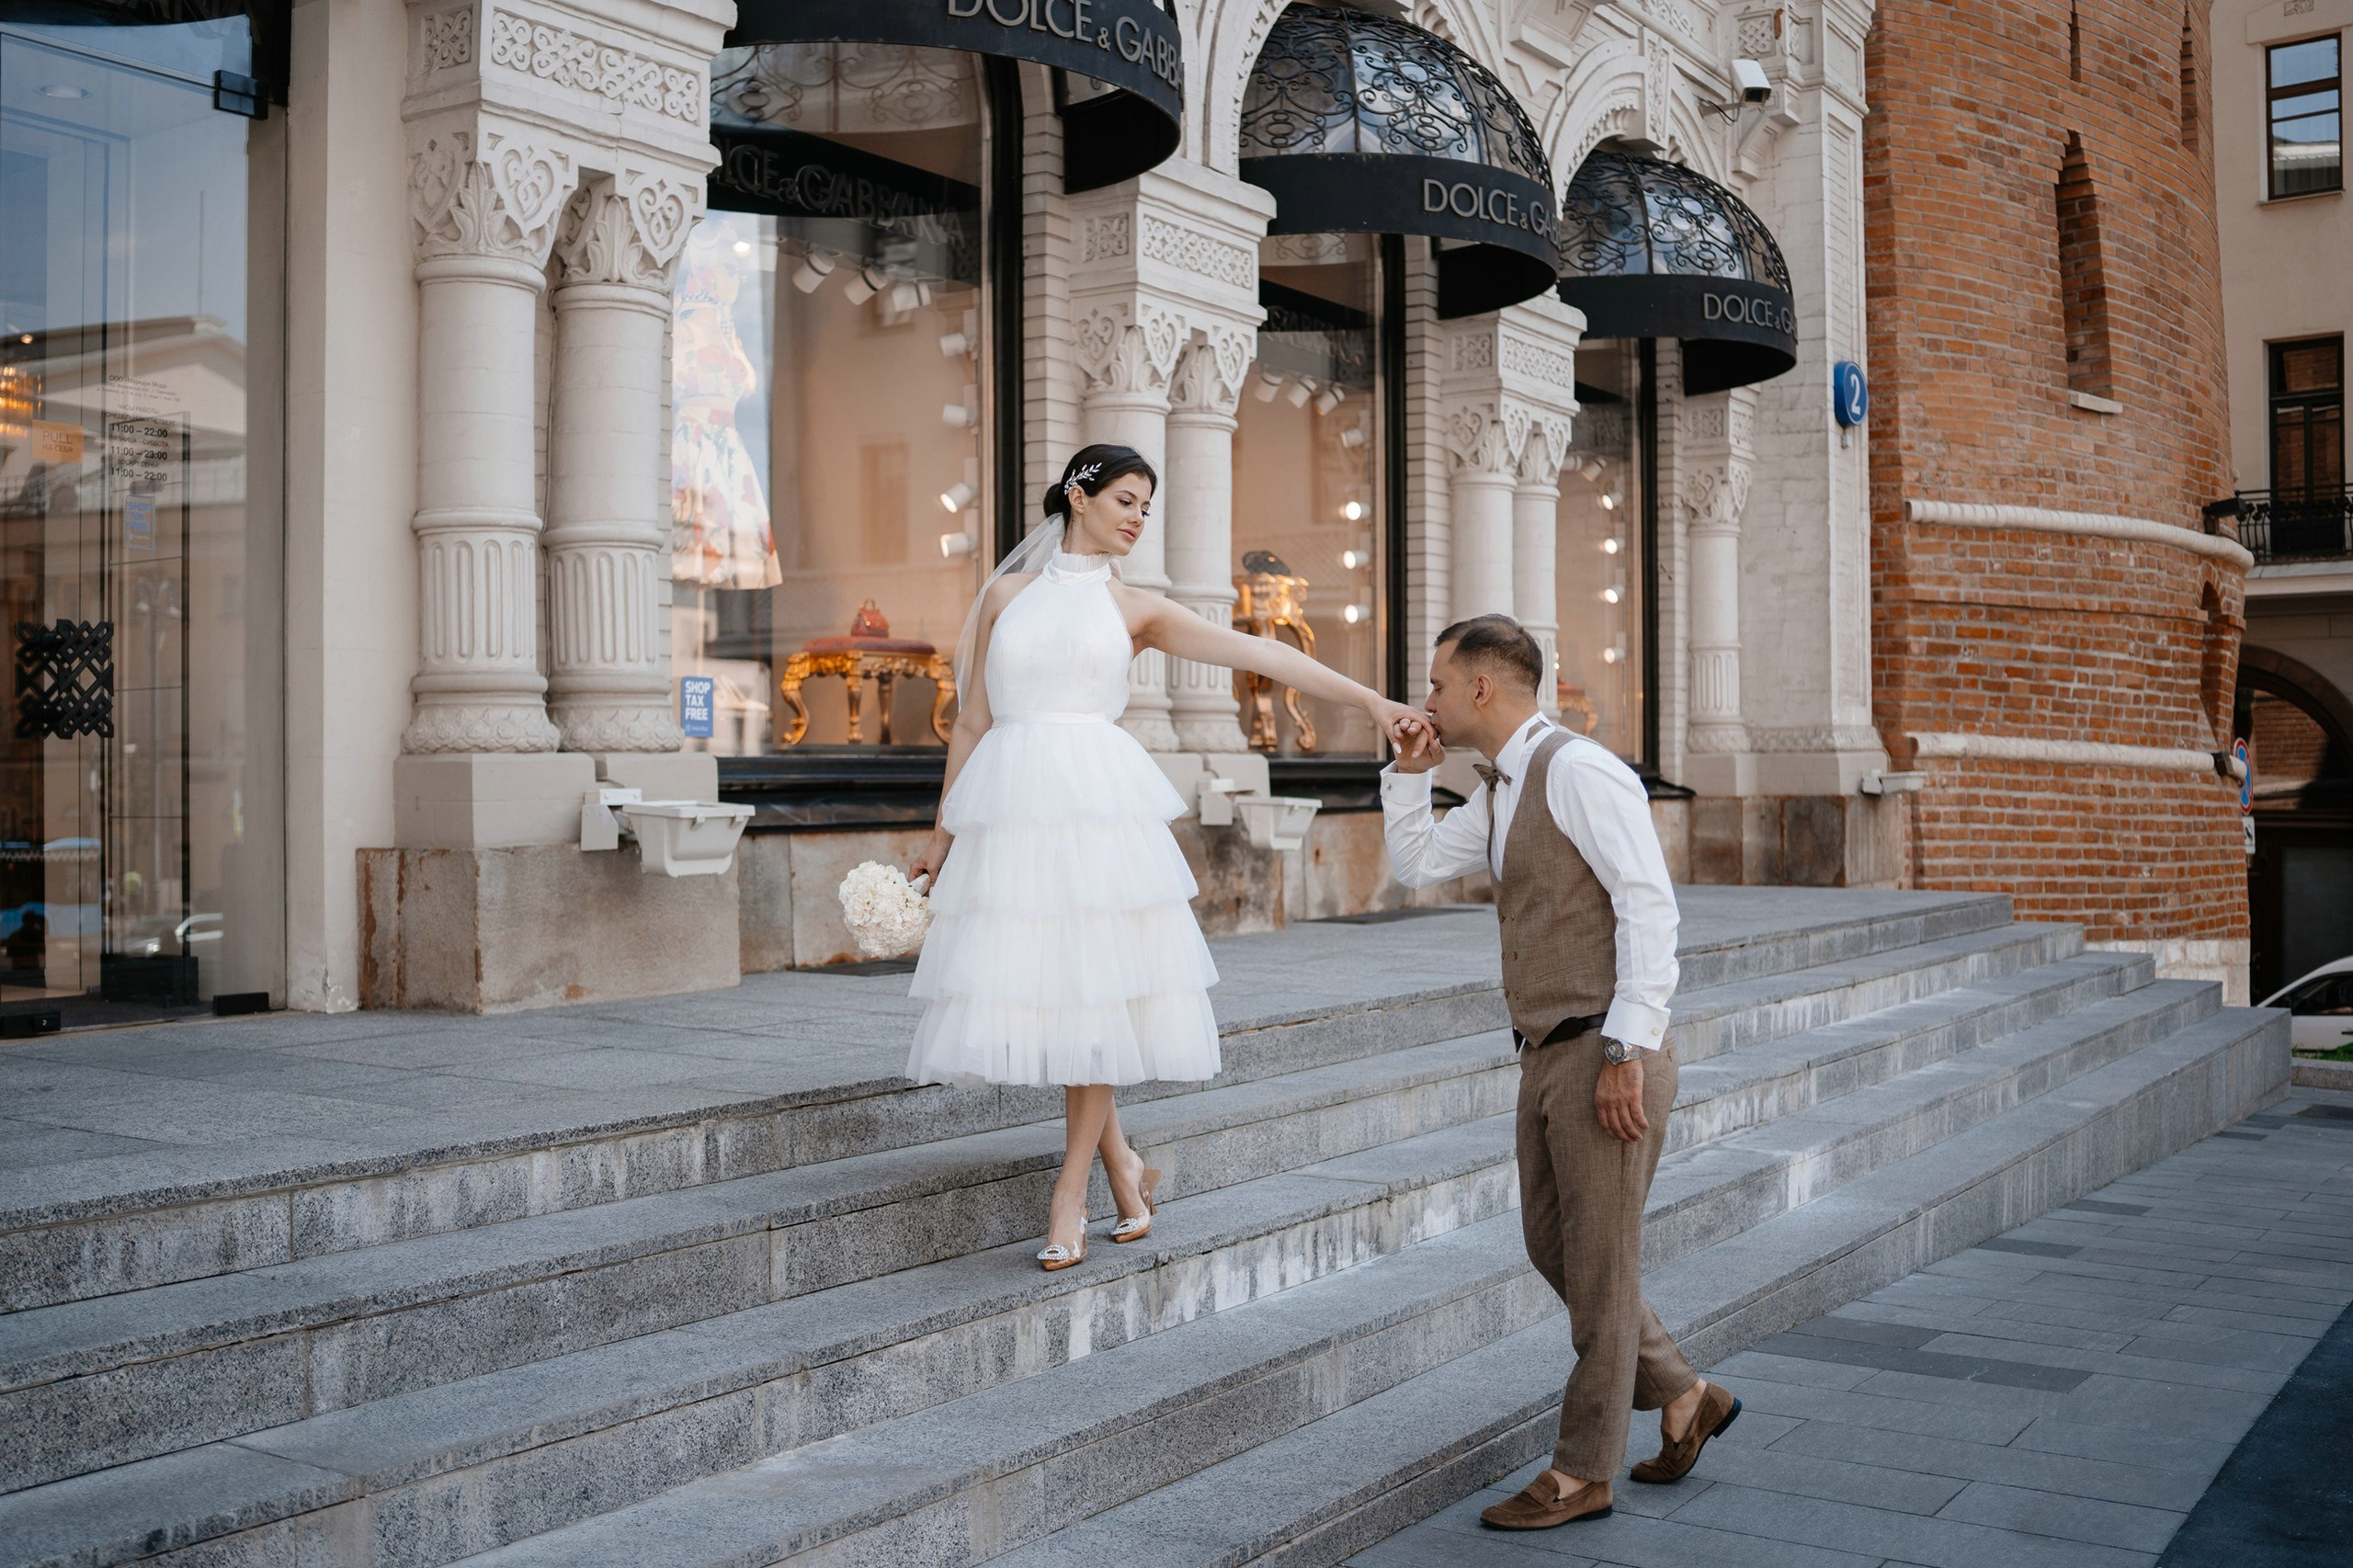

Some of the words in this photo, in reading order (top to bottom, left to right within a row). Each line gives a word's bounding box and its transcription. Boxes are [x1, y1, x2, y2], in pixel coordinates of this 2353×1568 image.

[1097, 27, 1110, 51] &
[1424, 177, 1518, 226] DOLCE
[1519, 212, 1529, 231] &
[1704, 293, 1773, 327] DOLCE
[1775, 315, 1781, 330] &
[1850, 373, 1861, 415] 2
[136, 406, 159, 415] РАБОТЫ
[110, 423, 134, 434] 11:00
[144, 426, 168, 437] 22:00
[42, 430, 73, 445] PULL
[108, 434, 137, 443] ПЯТНИЦА
[142, 439, 169, 448] СУББОТА
[55, 445, 74, 453] СЕБЯ
[111, 446, 134, 456] 11:00
[144, 449, 168, 460] 23:00
[111, 467, 134, 478] 11:00
[144, 471, 167, 482] 22:00
[685, 680, 711, 694] SHOP
[685, 694, 705, 707] TAX
[685, 708, 709, 721] FREE
